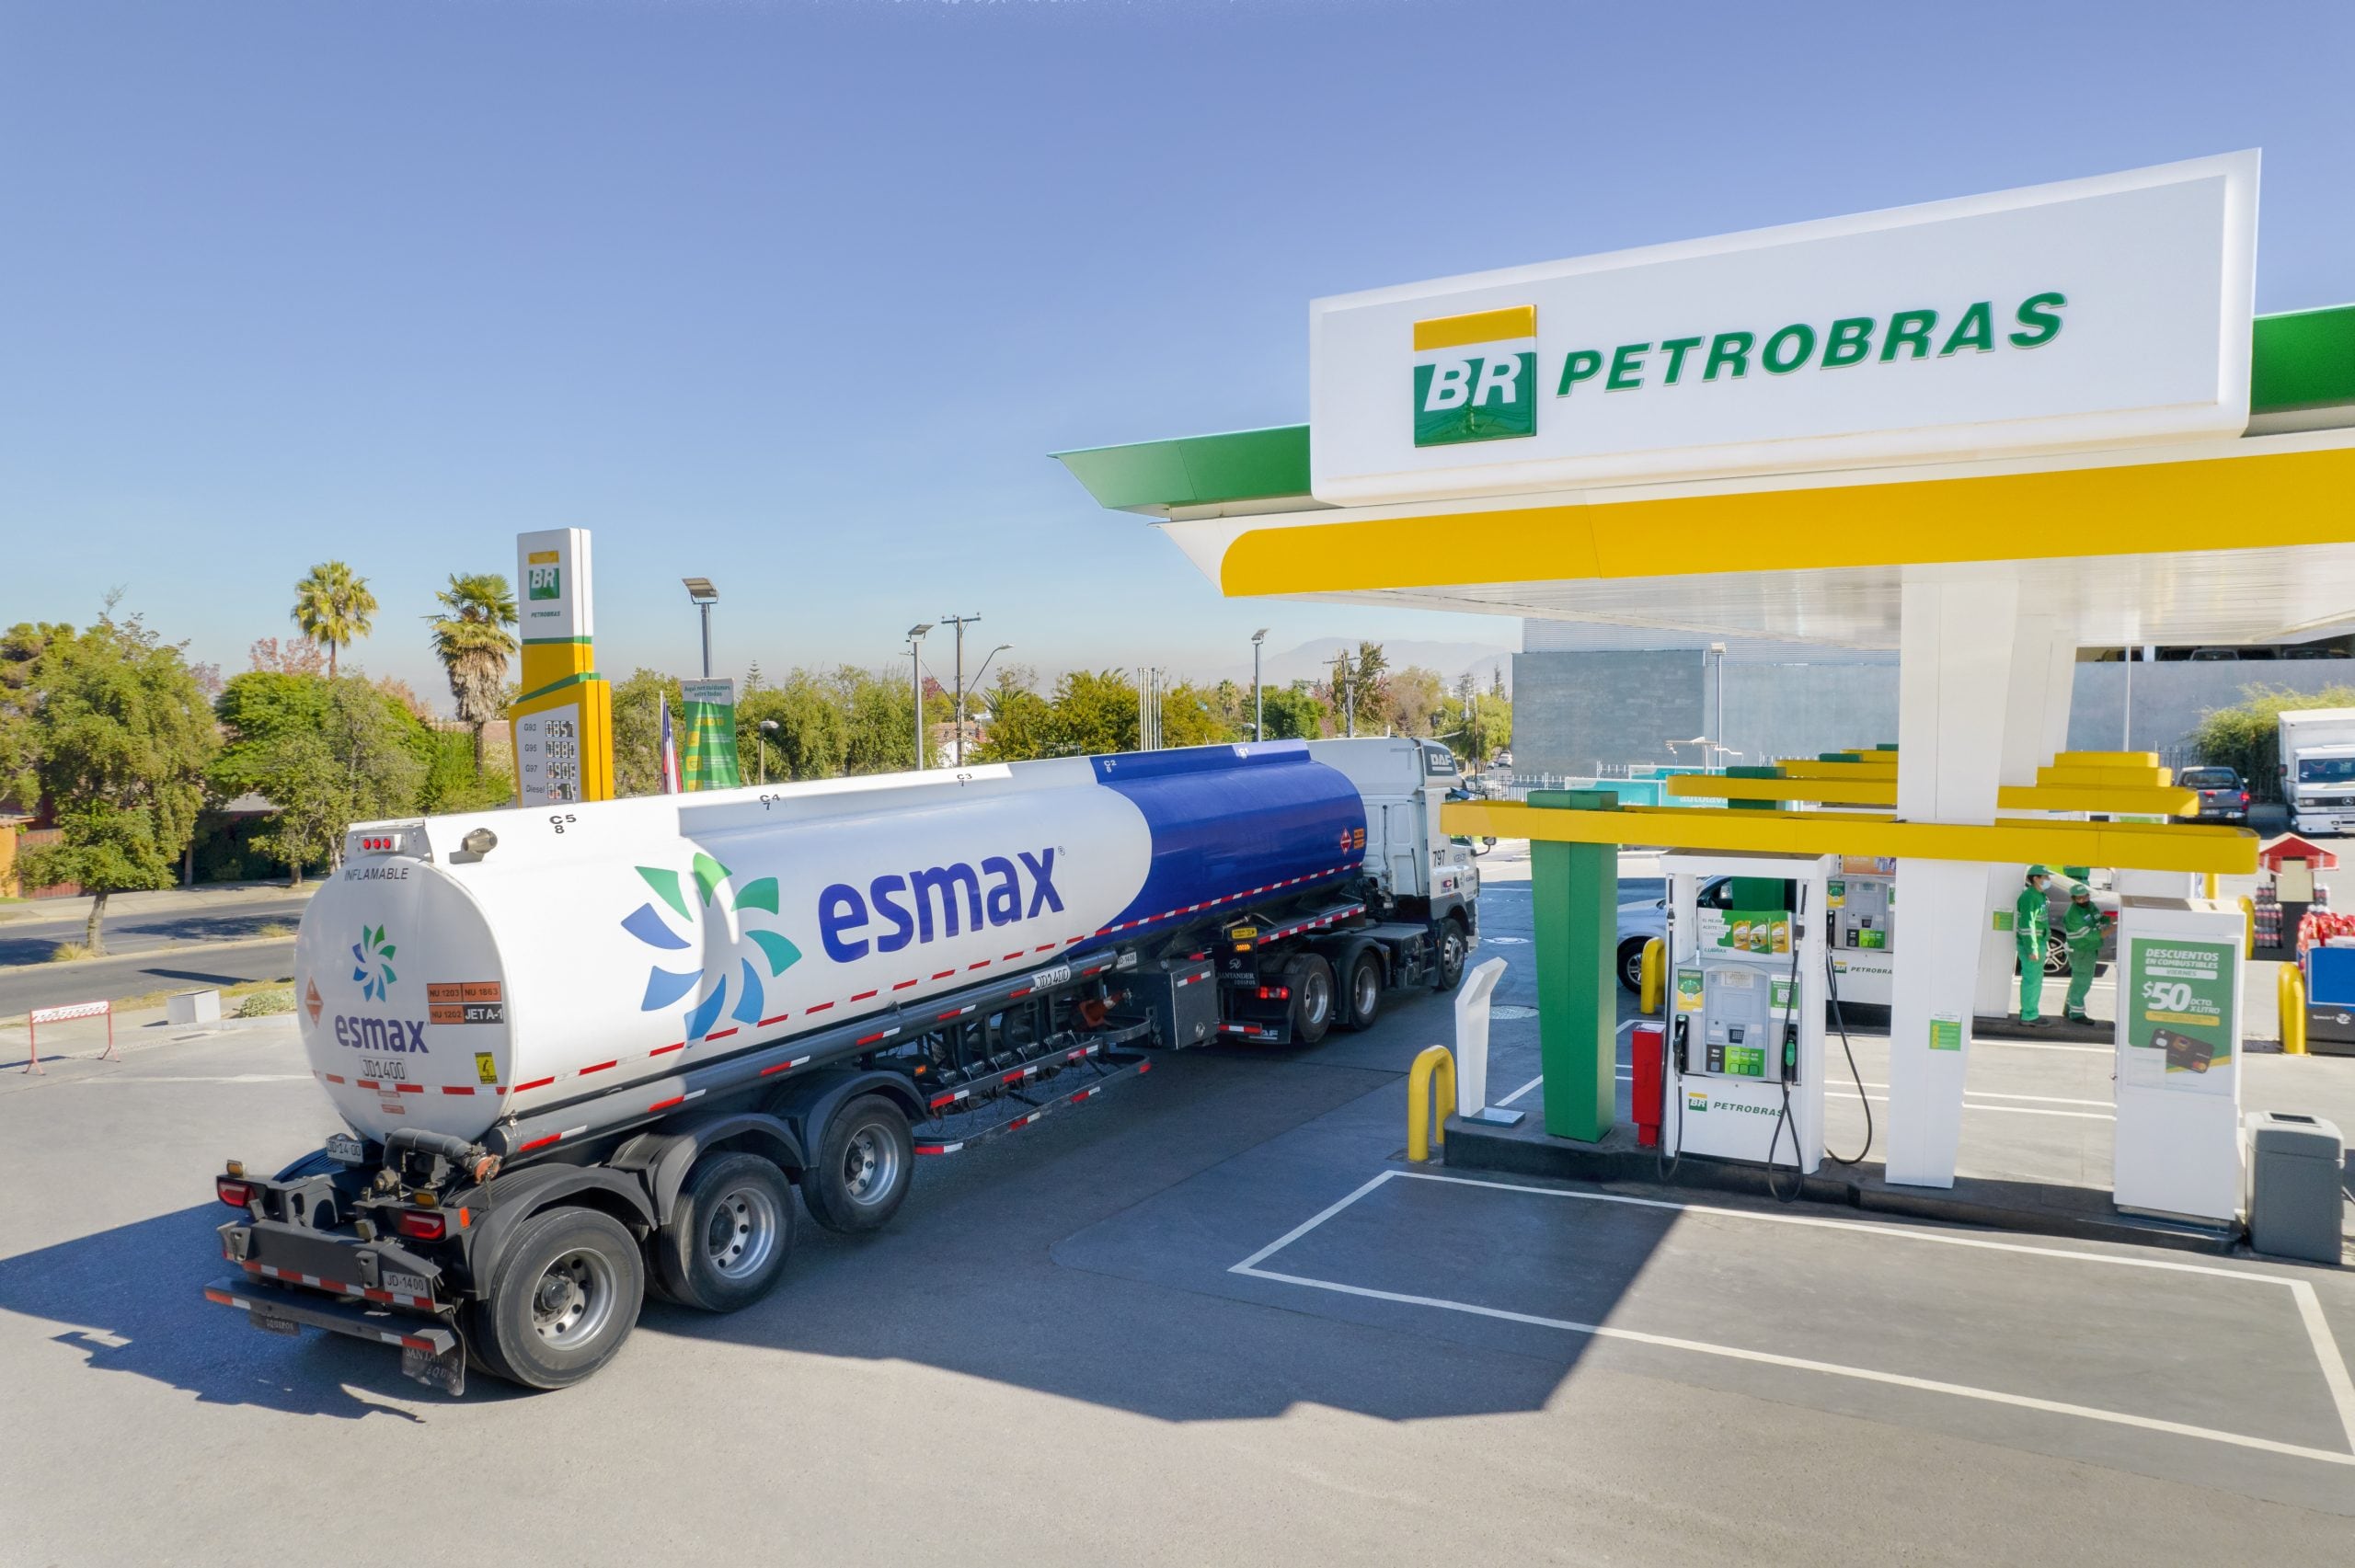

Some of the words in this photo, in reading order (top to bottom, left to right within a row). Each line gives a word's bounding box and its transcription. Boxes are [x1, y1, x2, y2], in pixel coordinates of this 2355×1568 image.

[1423, 352, 1522, 412] BR
[1556, 291, 2068, 398] PETROBRAS
[531, 567, 556, 589] BR
[523, 723, 536, 732] G93
[524, 743, 537, 752] G95
[1430, 753, 1452, 766] DAF
[525, 764, 538, 773] G97
[526, 784, 546, 794] Diesel
[1679, 795, 1728, 804] autolava
[763, 802, 771, 811] 7
[554, 824, 565, 834] 8
[1432, 849, 1446, 867] 797
[344, 867, 409, 881] INFLAMABLE
[818, 847, 1064, 963] esmax
[2145, 948, 2219, 962] DESCUENTOS
[2157, 958, 2219, 969] COMBUSTIBLES
[1851, 966, 1892, 975] PETROBRA
[429, 990, 441, 998] NU
[442, 989, 460, 998] 1203
[465, 988, 477, 997] NU
[2142, 980, 2192, 1012] $50
[465, 1008, 485, 1020] JET
[486, 1008, 503, 1020] A-1
[2197, 1006, 2221, 1014] LITRO
[335, 1014, 430, 1053] esmax
[362, 1059, 406, 1081] JD1400
[1689, 1098, 1706, 1108] BR
[1714, 1101, 1783, 1117] PETROBRAS
